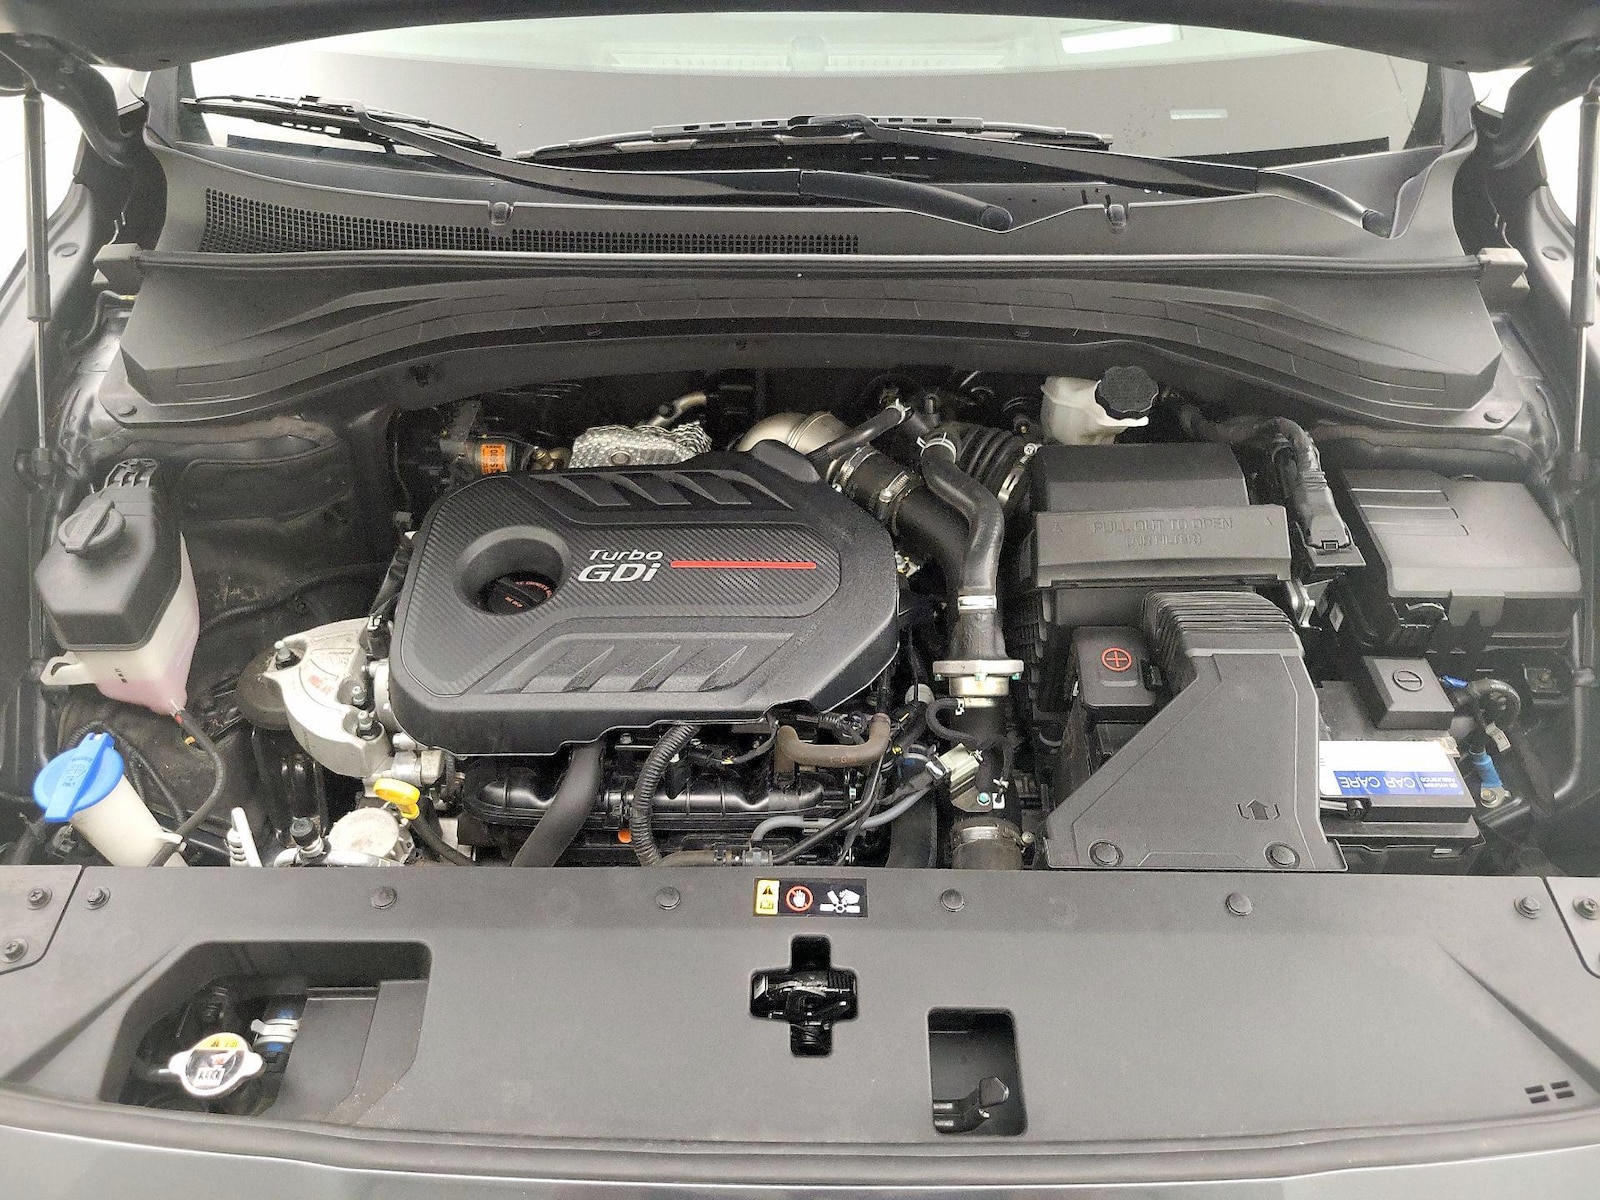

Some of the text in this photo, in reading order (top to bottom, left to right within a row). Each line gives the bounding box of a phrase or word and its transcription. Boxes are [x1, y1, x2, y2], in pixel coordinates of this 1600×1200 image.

[1093, 517, 1233, 533] PULL OUT TO OPEN
[589, 549, 664, 561] Turbo
[577, 562, 662, 582] GDi
[1338, 776, 1381, 789] CARE
[1383, 776, 1416, 789] CAR
